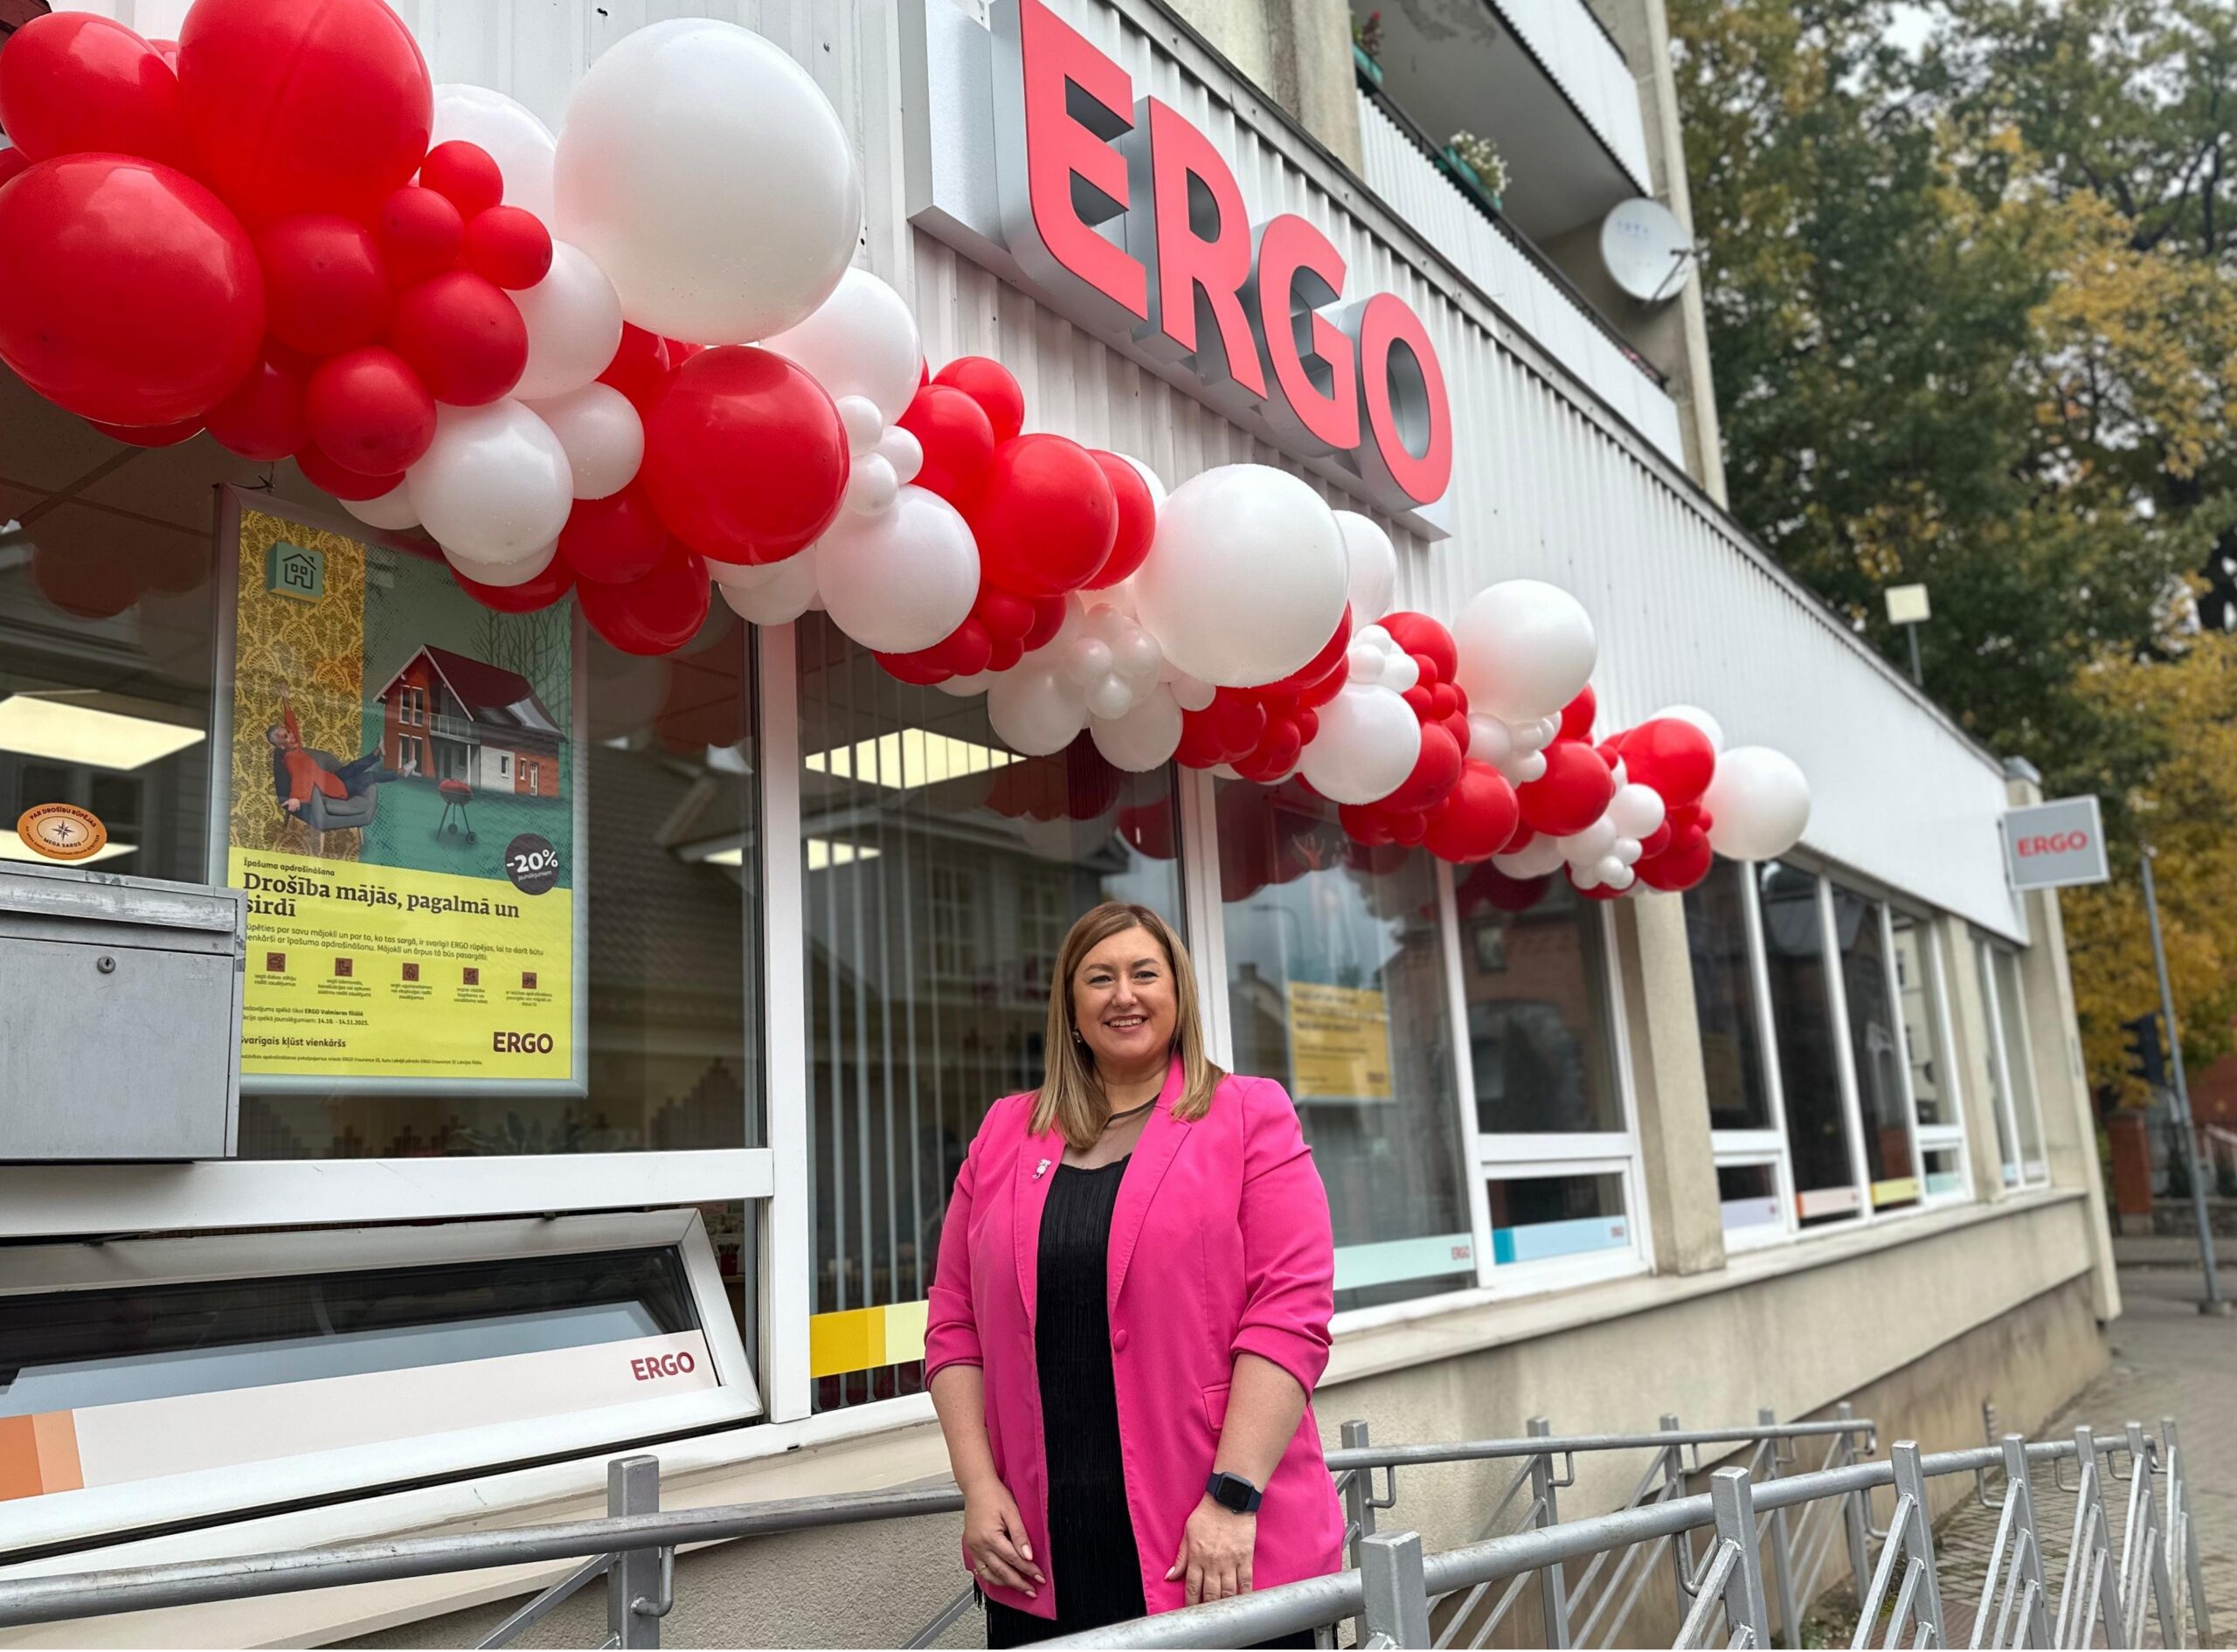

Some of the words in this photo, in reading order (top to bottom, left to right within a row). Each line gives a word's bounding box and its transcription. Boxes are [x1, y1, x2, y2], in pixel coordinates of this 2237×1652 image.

[1019, 0, 1452, 504] ERGO
[44, 838, 60, 847] MEGA
[2017, 831, 2088, 858] ERGO
[244, 857, 278, 869] Īpašuma
[280, 863, 335, 876] apdrošināšana
[507, 849, 558, 873] -20%
[243, 873, 330, 898] Drošība
[336, 884, 402, 909] mājās,
[407, 894, 489, 916] pagalmā
[495, 903, 519, 917] un
[246, 895, 295, 916] sirdī
[287, 937, 319, 947] īpašuma
[414, 948, 433, 957] ārpus
[282, 1037, 303, 1048] kļūst
[306, 1038, 346, 1047] vienkāršs
[493, 1031, 553, 1054] ERGO
[631, 1351, 695, 1380] ERGO
